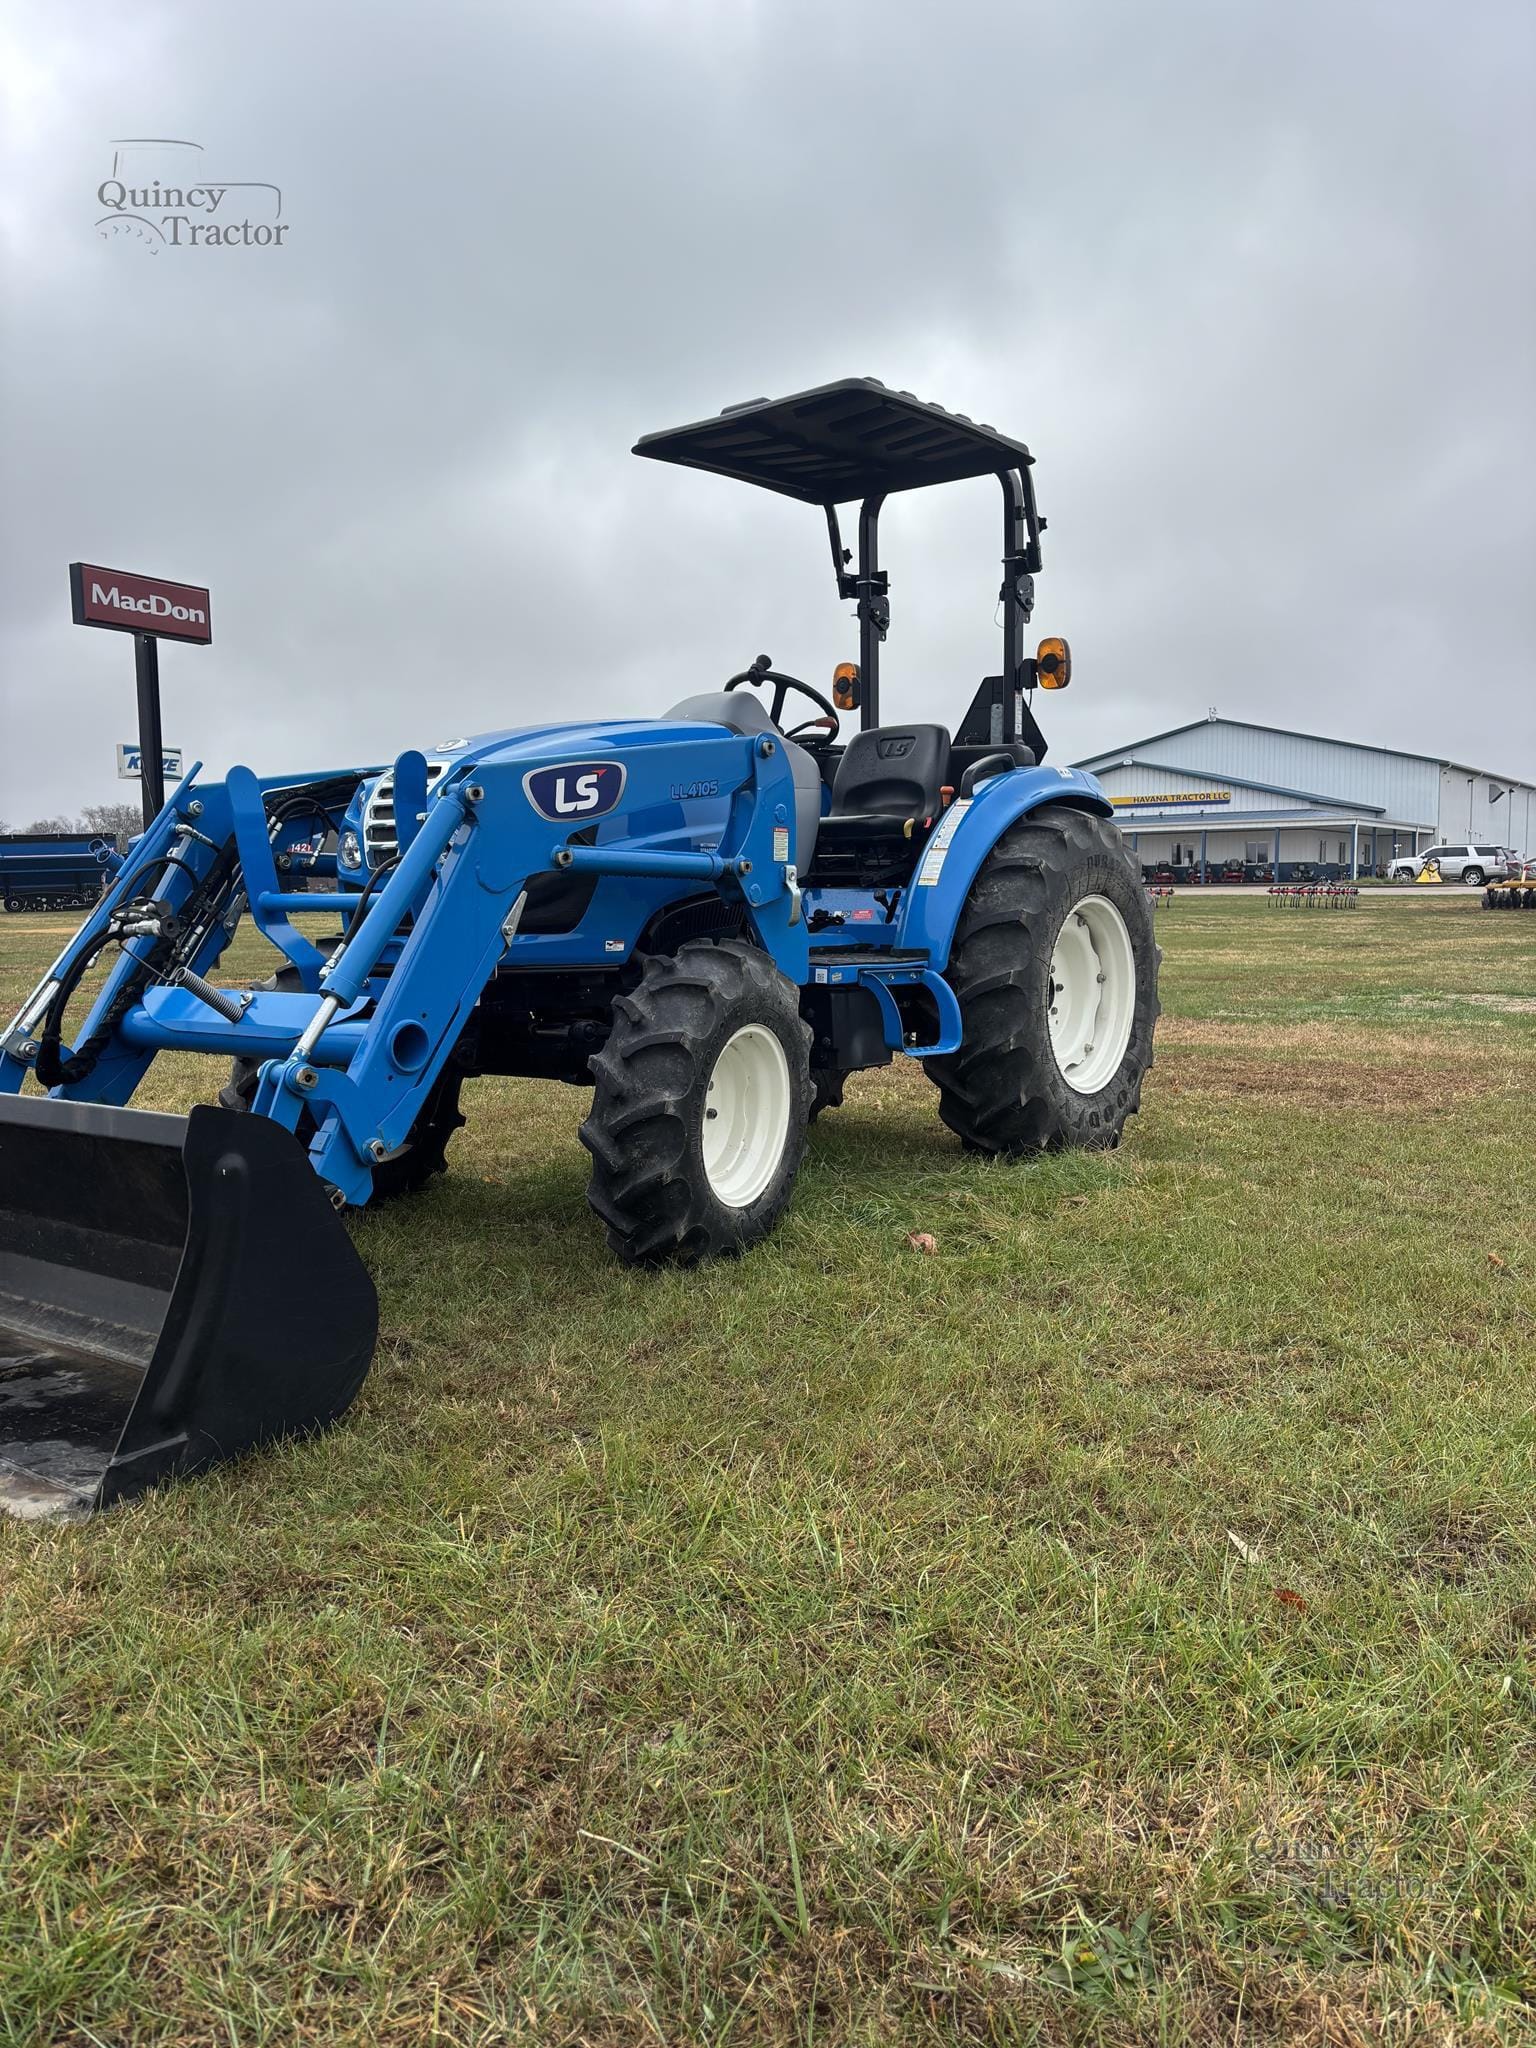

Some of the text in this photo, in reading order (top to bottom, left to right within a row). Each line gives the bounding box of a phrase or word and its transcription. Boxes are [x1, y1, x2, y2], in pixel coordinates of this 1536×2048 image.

[91, 583, 205, 623] MacDon
[127, 756, 180, 772] KZE
[555, 774, 599, 813] LS
[670, 780, 719, 800] LL4105
[1170, 793, 1211, 802] TRACTOR
[1213, 792, 1230, 800] LLC
